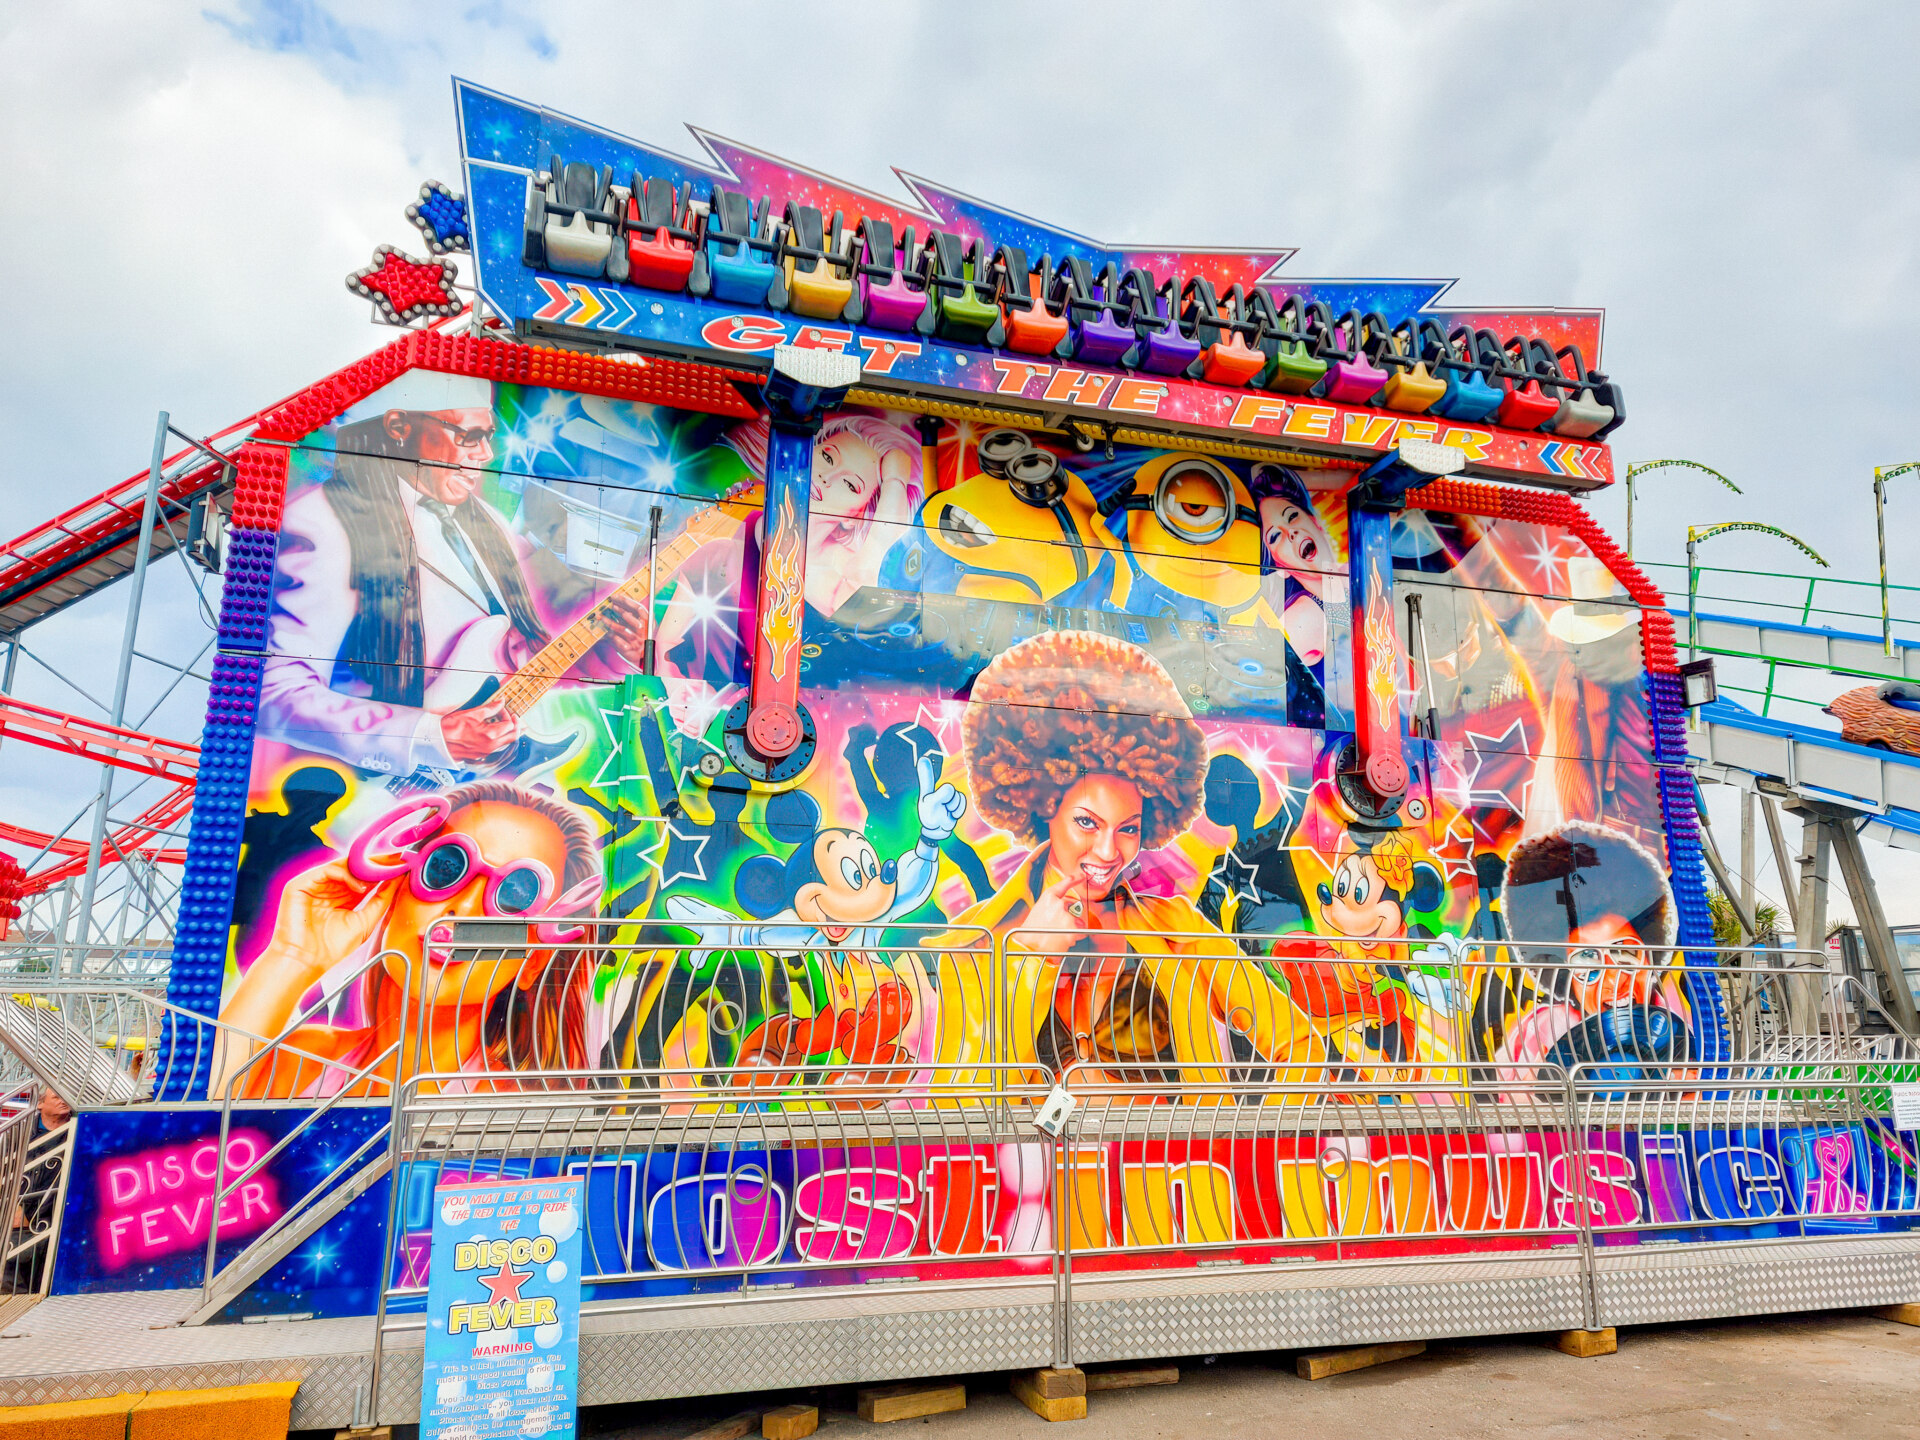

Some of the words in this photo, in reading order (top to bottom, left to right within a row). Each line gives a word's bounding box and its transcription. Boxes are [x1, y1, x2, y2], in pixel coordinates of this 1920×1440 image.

[701, 314, 922, 374] GET
[992, 358, 1168, 414] THE
[1229, 394, 1494, 462] FEVER
[109, 1138, 255, 1204] DISCO
[444, 1196, 467, 1208] YOU
[470, 1193, 501, 1205] MUST
[504, 1192, 517, 1202] BE
[520, 1190, 532, 1200] AS
[537, 1188, 560, 1199] TALL
[565, 1187, 576, 1197] AS
[567, 1154, 1006, 1274] lost
[1056, 1145, 1237, 1250] in
[1278, 1134, 1786, 1238] music
[451, 1210, 470, 1220] THE
[472, 1207, 494, 1218] RED
[497, 1205, 521, 1217] LINE
[525, 1204, 540, 1214] TO
[543, 1202, 568, 1213] RIDE
[500, 1219, 520, 1230] THE
[455, 1236, 556, 1270] DISCO
[450, 1297, 557, 1334] FEVER
[472, 1342, 533, 1357] WARNING
[537, 1365, 551, 1373] ride
[444, 1397, 458, 1405] you
[499, 1400, 514, 1409] you
